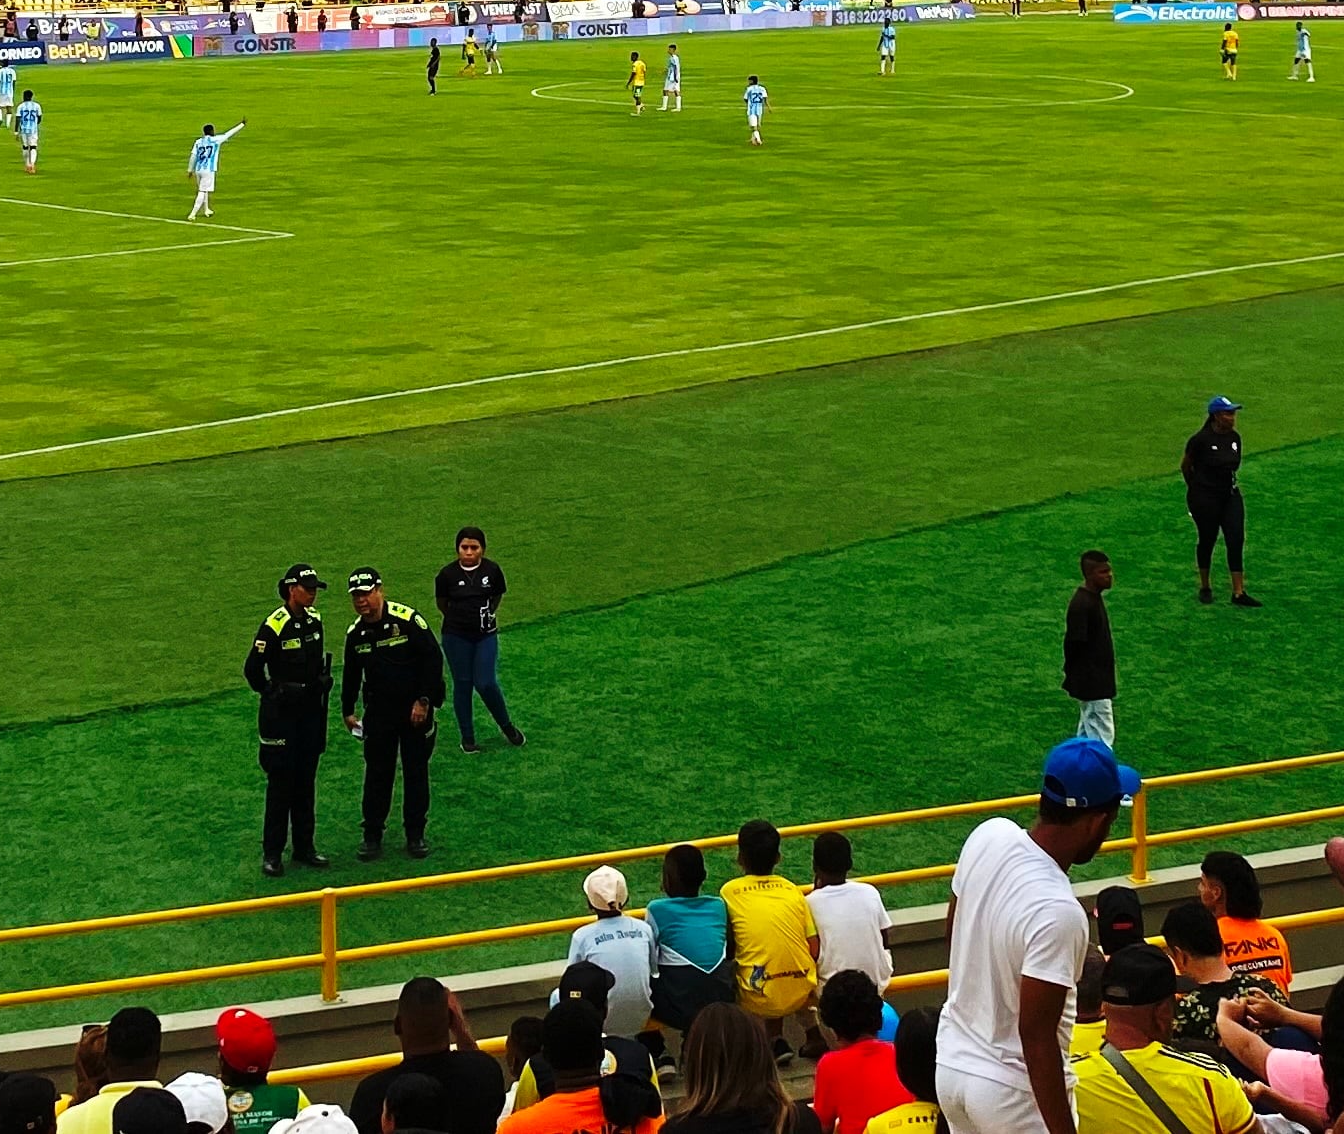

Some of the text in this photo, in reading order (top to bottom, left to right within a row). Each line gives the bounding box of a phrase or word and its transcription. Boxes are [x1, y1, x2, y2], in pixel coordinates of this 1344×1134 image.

[1158, 3, 1237, 20] Electrolit
[577, 23, 629, 37] CONSTR
[48, 40, 108, 61] BetPlay
[109, 40, 165, 54] DIMAYOR
[234, 37, 298, 53] CONSTR
[198, 145, 214, 161] 27
